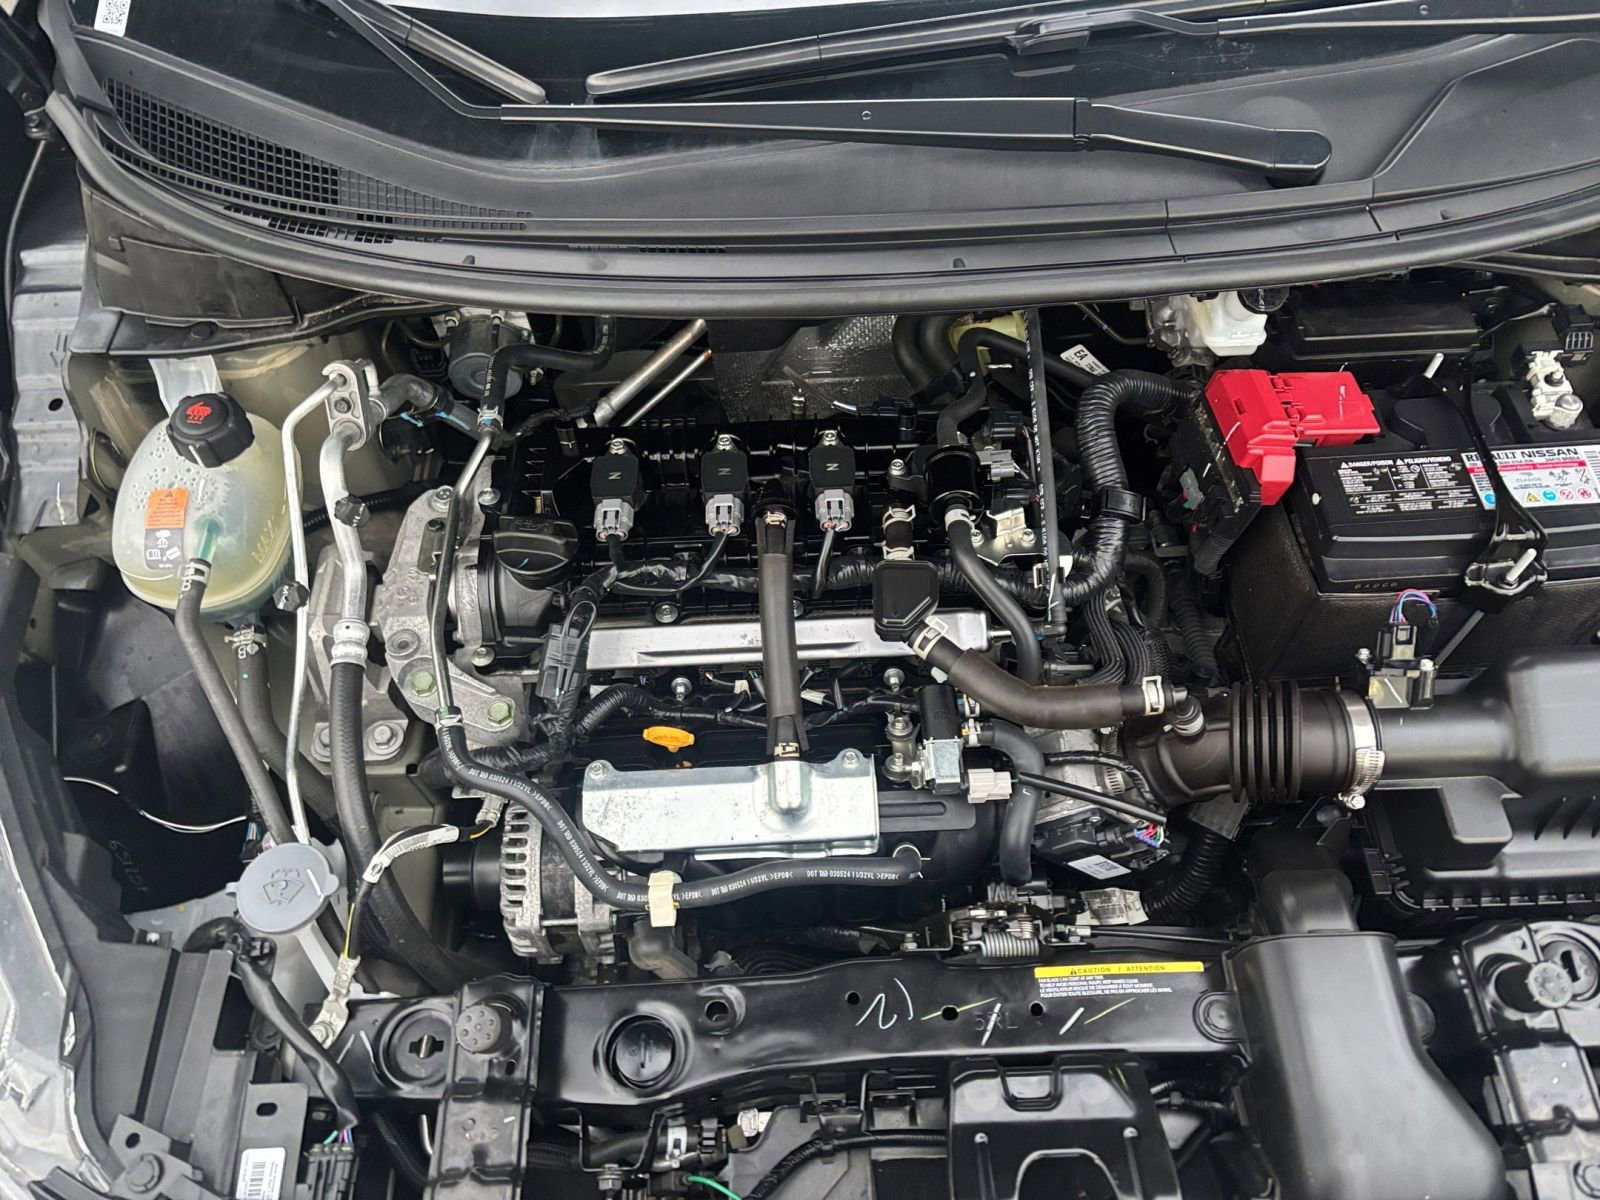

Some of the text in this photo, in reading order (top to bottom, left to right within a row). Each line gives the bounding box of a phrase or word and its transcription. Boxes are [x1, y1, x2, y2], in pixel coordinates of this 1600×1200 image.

[1074, 349, 1088, 360] EA
[1464, 450, 1517, 462] REULT
[1521, 448, 1579, 458] NISSAN
